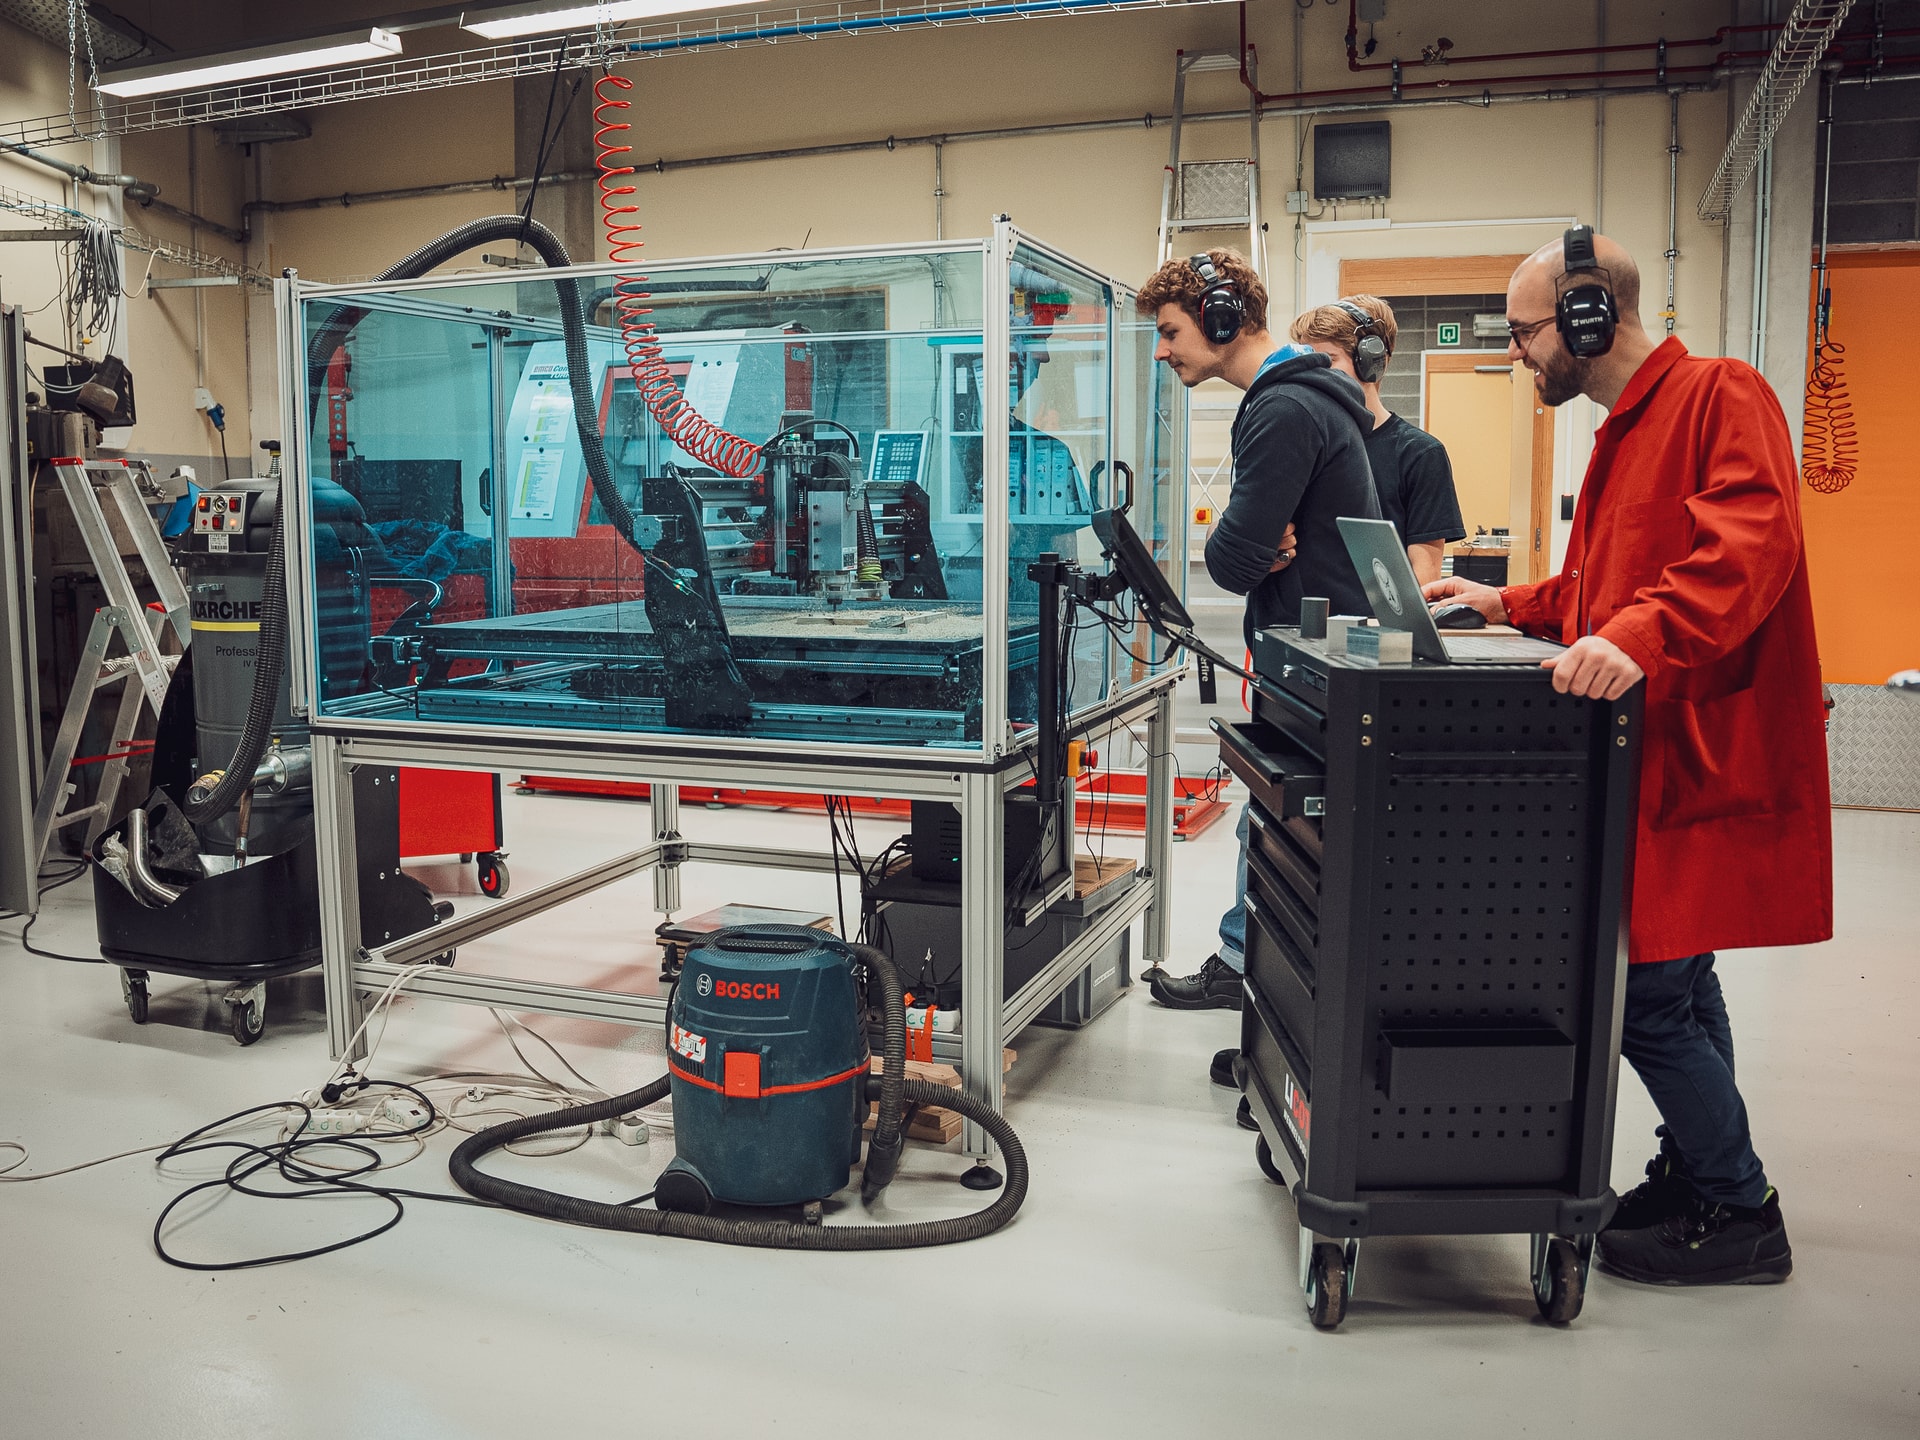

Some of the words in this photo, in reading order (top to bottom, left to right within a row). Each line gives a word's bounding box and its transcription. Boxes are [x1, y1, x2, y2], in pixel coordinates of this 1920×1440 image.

[192, 601, 262, 619] KÄRCHE
[216, 646, 259, 656] Professi
[715, 980, 780, 1000] BOSCH
[1284, 1072, 1310, 1139] LICOT
